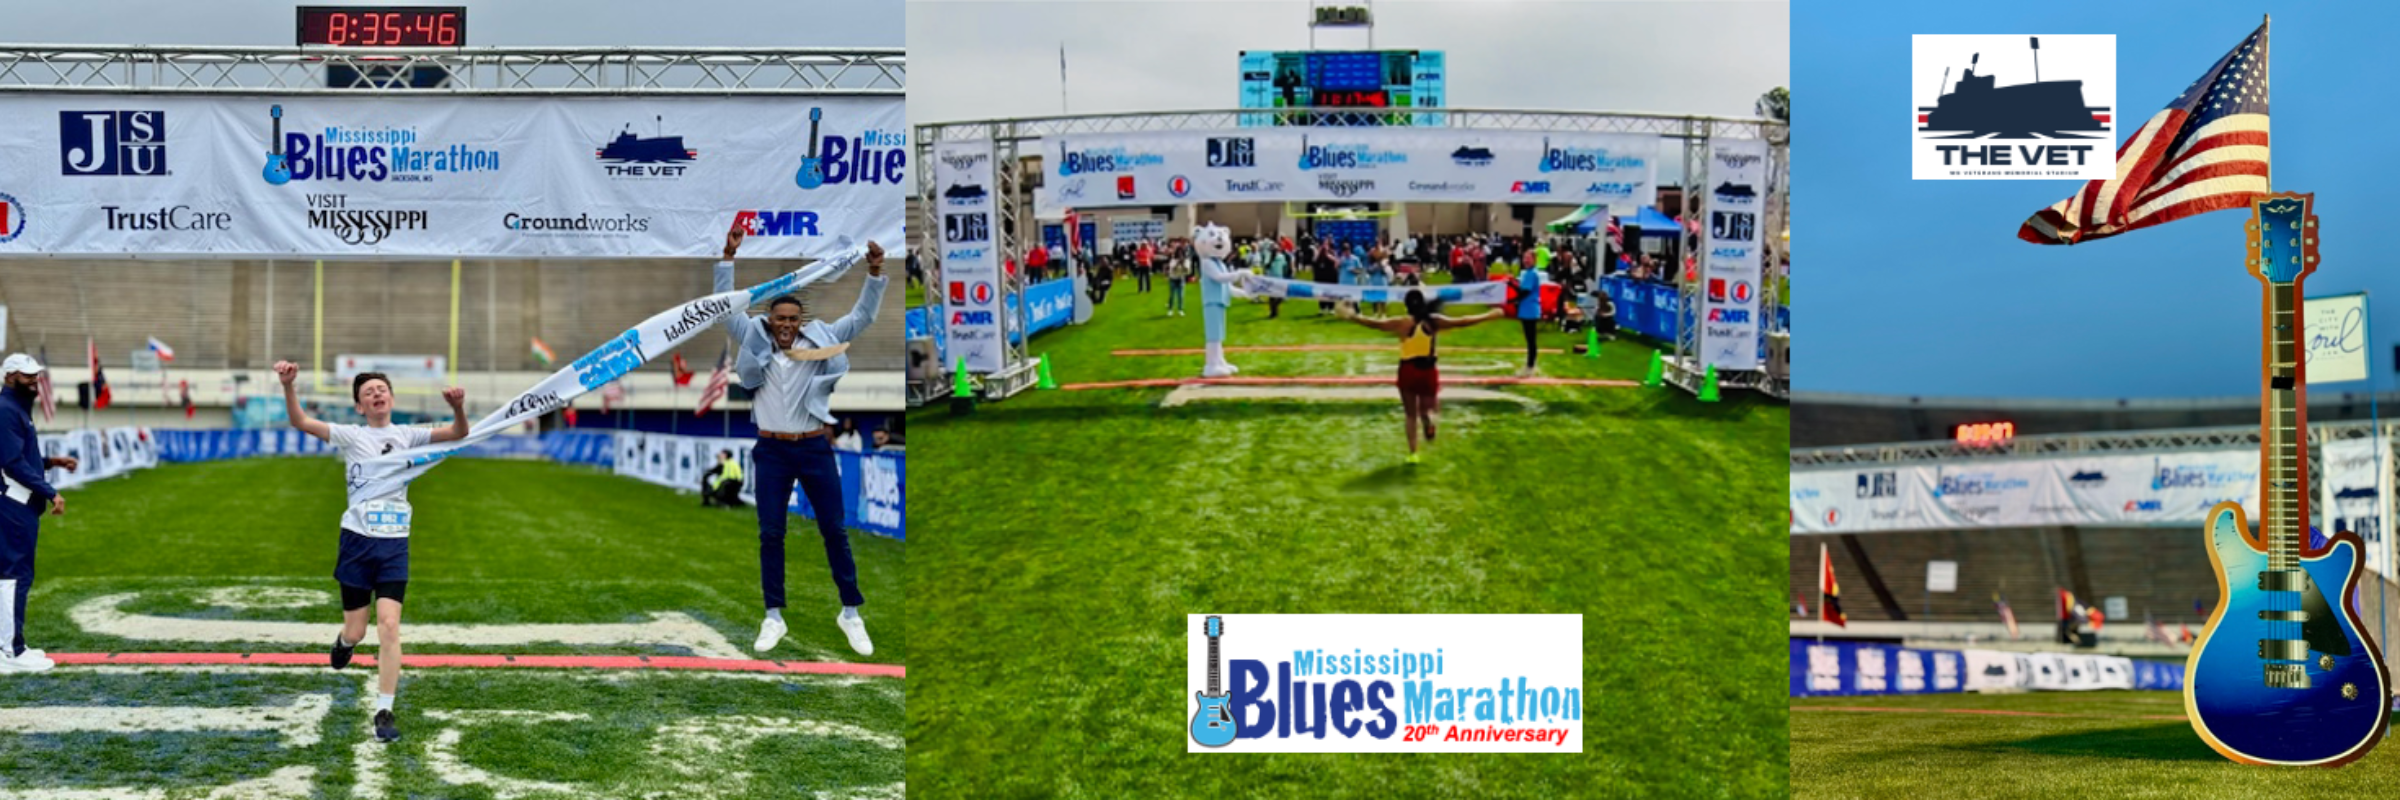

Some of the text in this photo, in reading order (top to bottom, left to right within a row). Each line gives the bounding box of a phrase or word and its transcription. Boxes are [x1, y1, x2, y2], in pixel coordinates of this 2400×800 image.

[325, 126, 416, 144] Mississippi
[286, 133, 388, 182] Blues
[391, 144, 499, 172] Marathon
[1068, 151, 1115, 174] Blues
[1309, 145, 1356, 169] Blues
[1550, 148, 1595, 171] Blues
[604, 166, 687, 176] THE VET
[1226, 179, 1284, 192] TrustCare
[1511, 181, 1550, 193] AMR
[306, 194, 347, 208] VISIT
[101, 205, 231, 230] TrustCare
[308, 210, 428, 246] MISSISSIPPI
[503, 212, 649, 233] Groundworks
